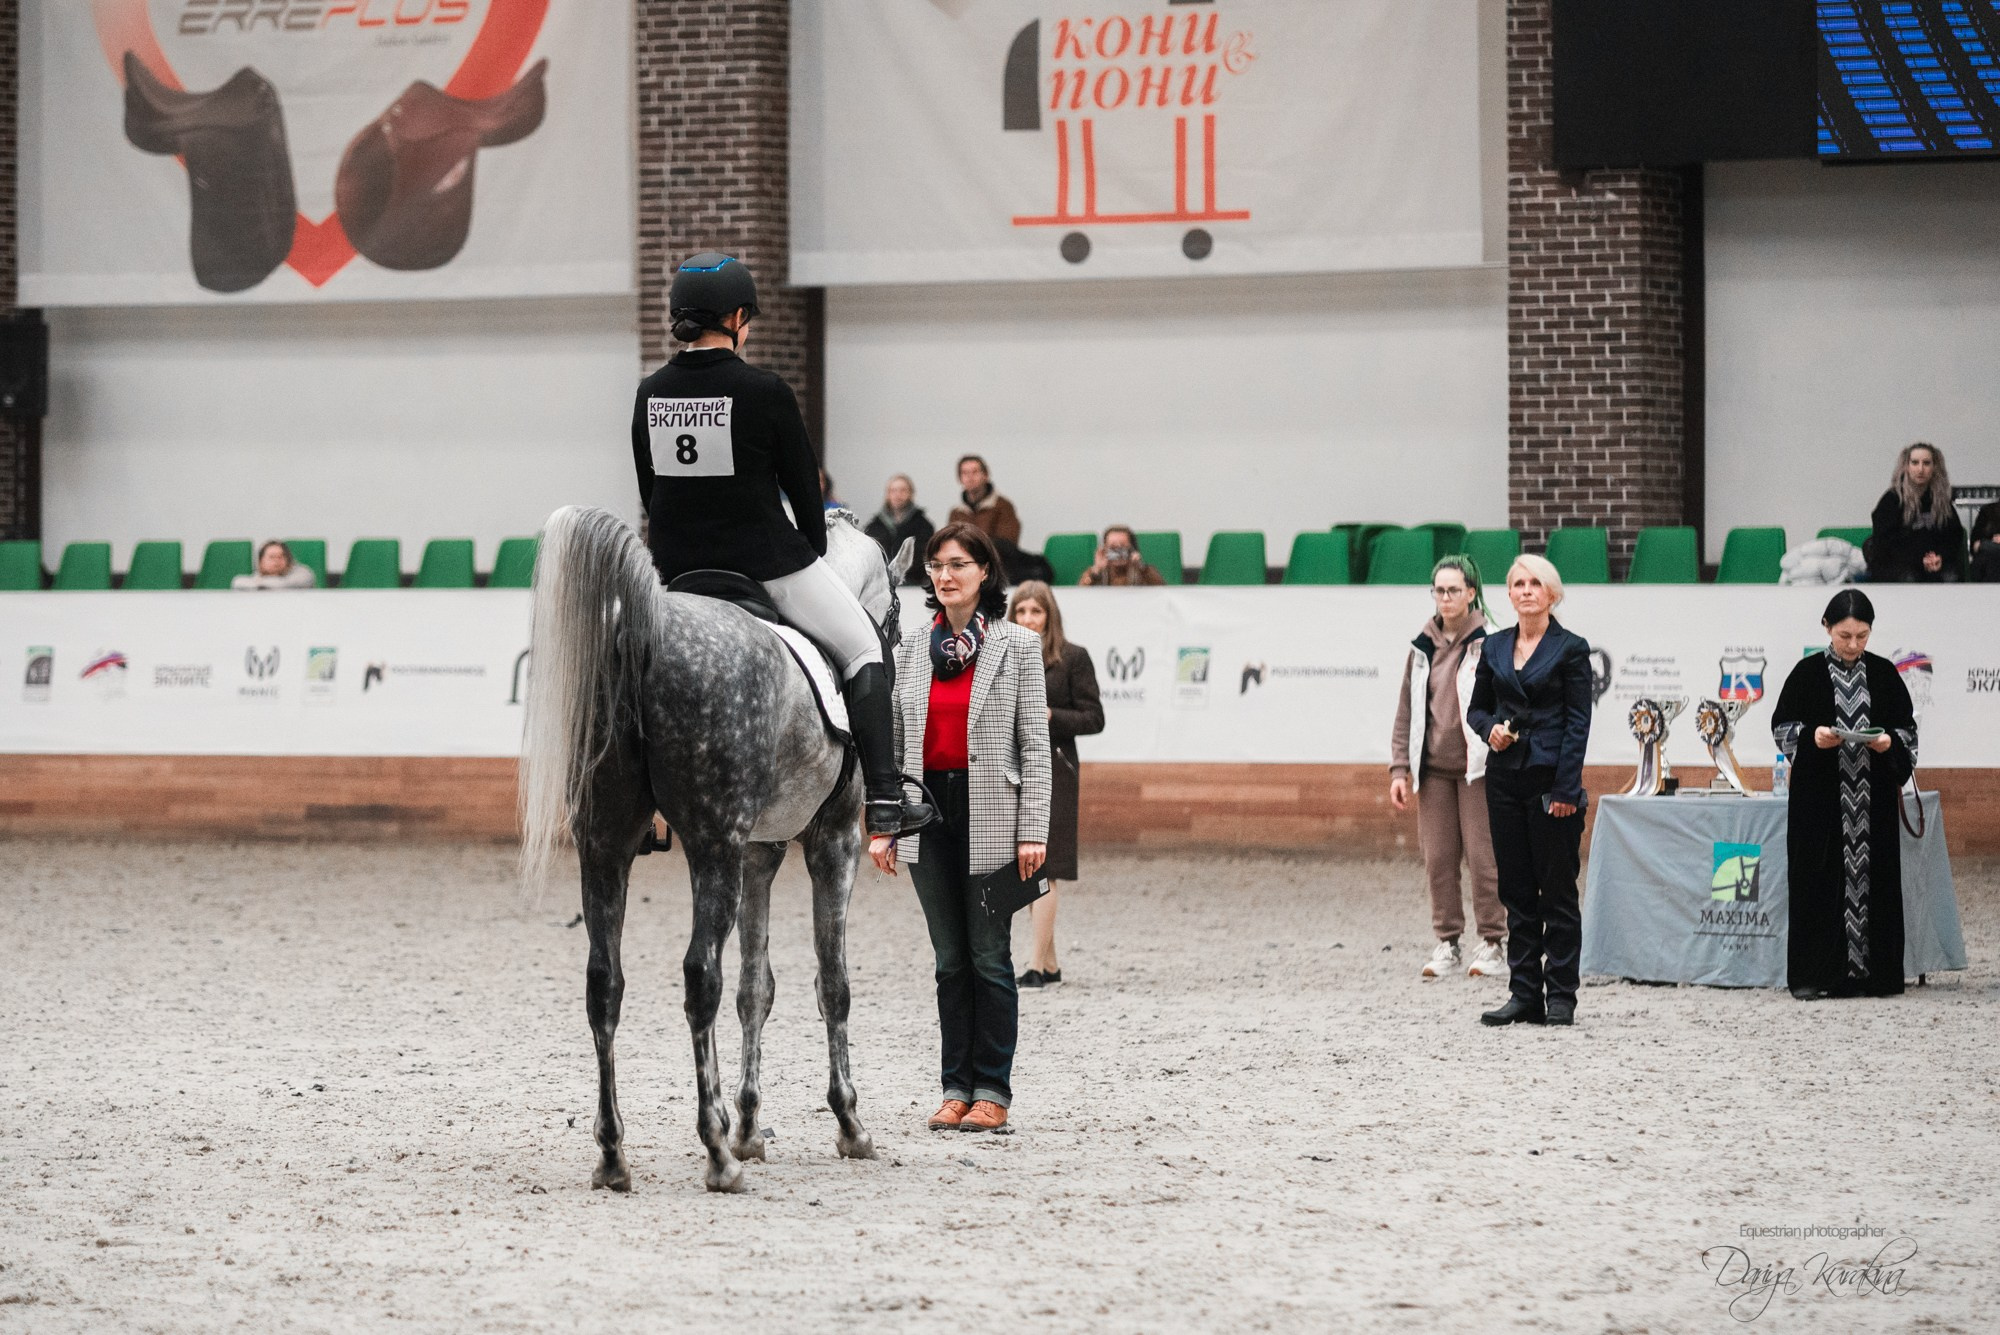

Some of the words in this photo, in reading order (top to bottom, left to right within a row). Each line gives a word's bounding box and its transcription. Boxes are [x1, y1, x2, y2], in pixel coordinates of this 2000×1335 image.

[650, 400, 725, 412] КРЫЛАТЫЙ
[650, 413, 726, 427] ЭКЛИПС
[676, 434, 698, 465] 8
[1700, 909, 1770, 926] MAXIMA
